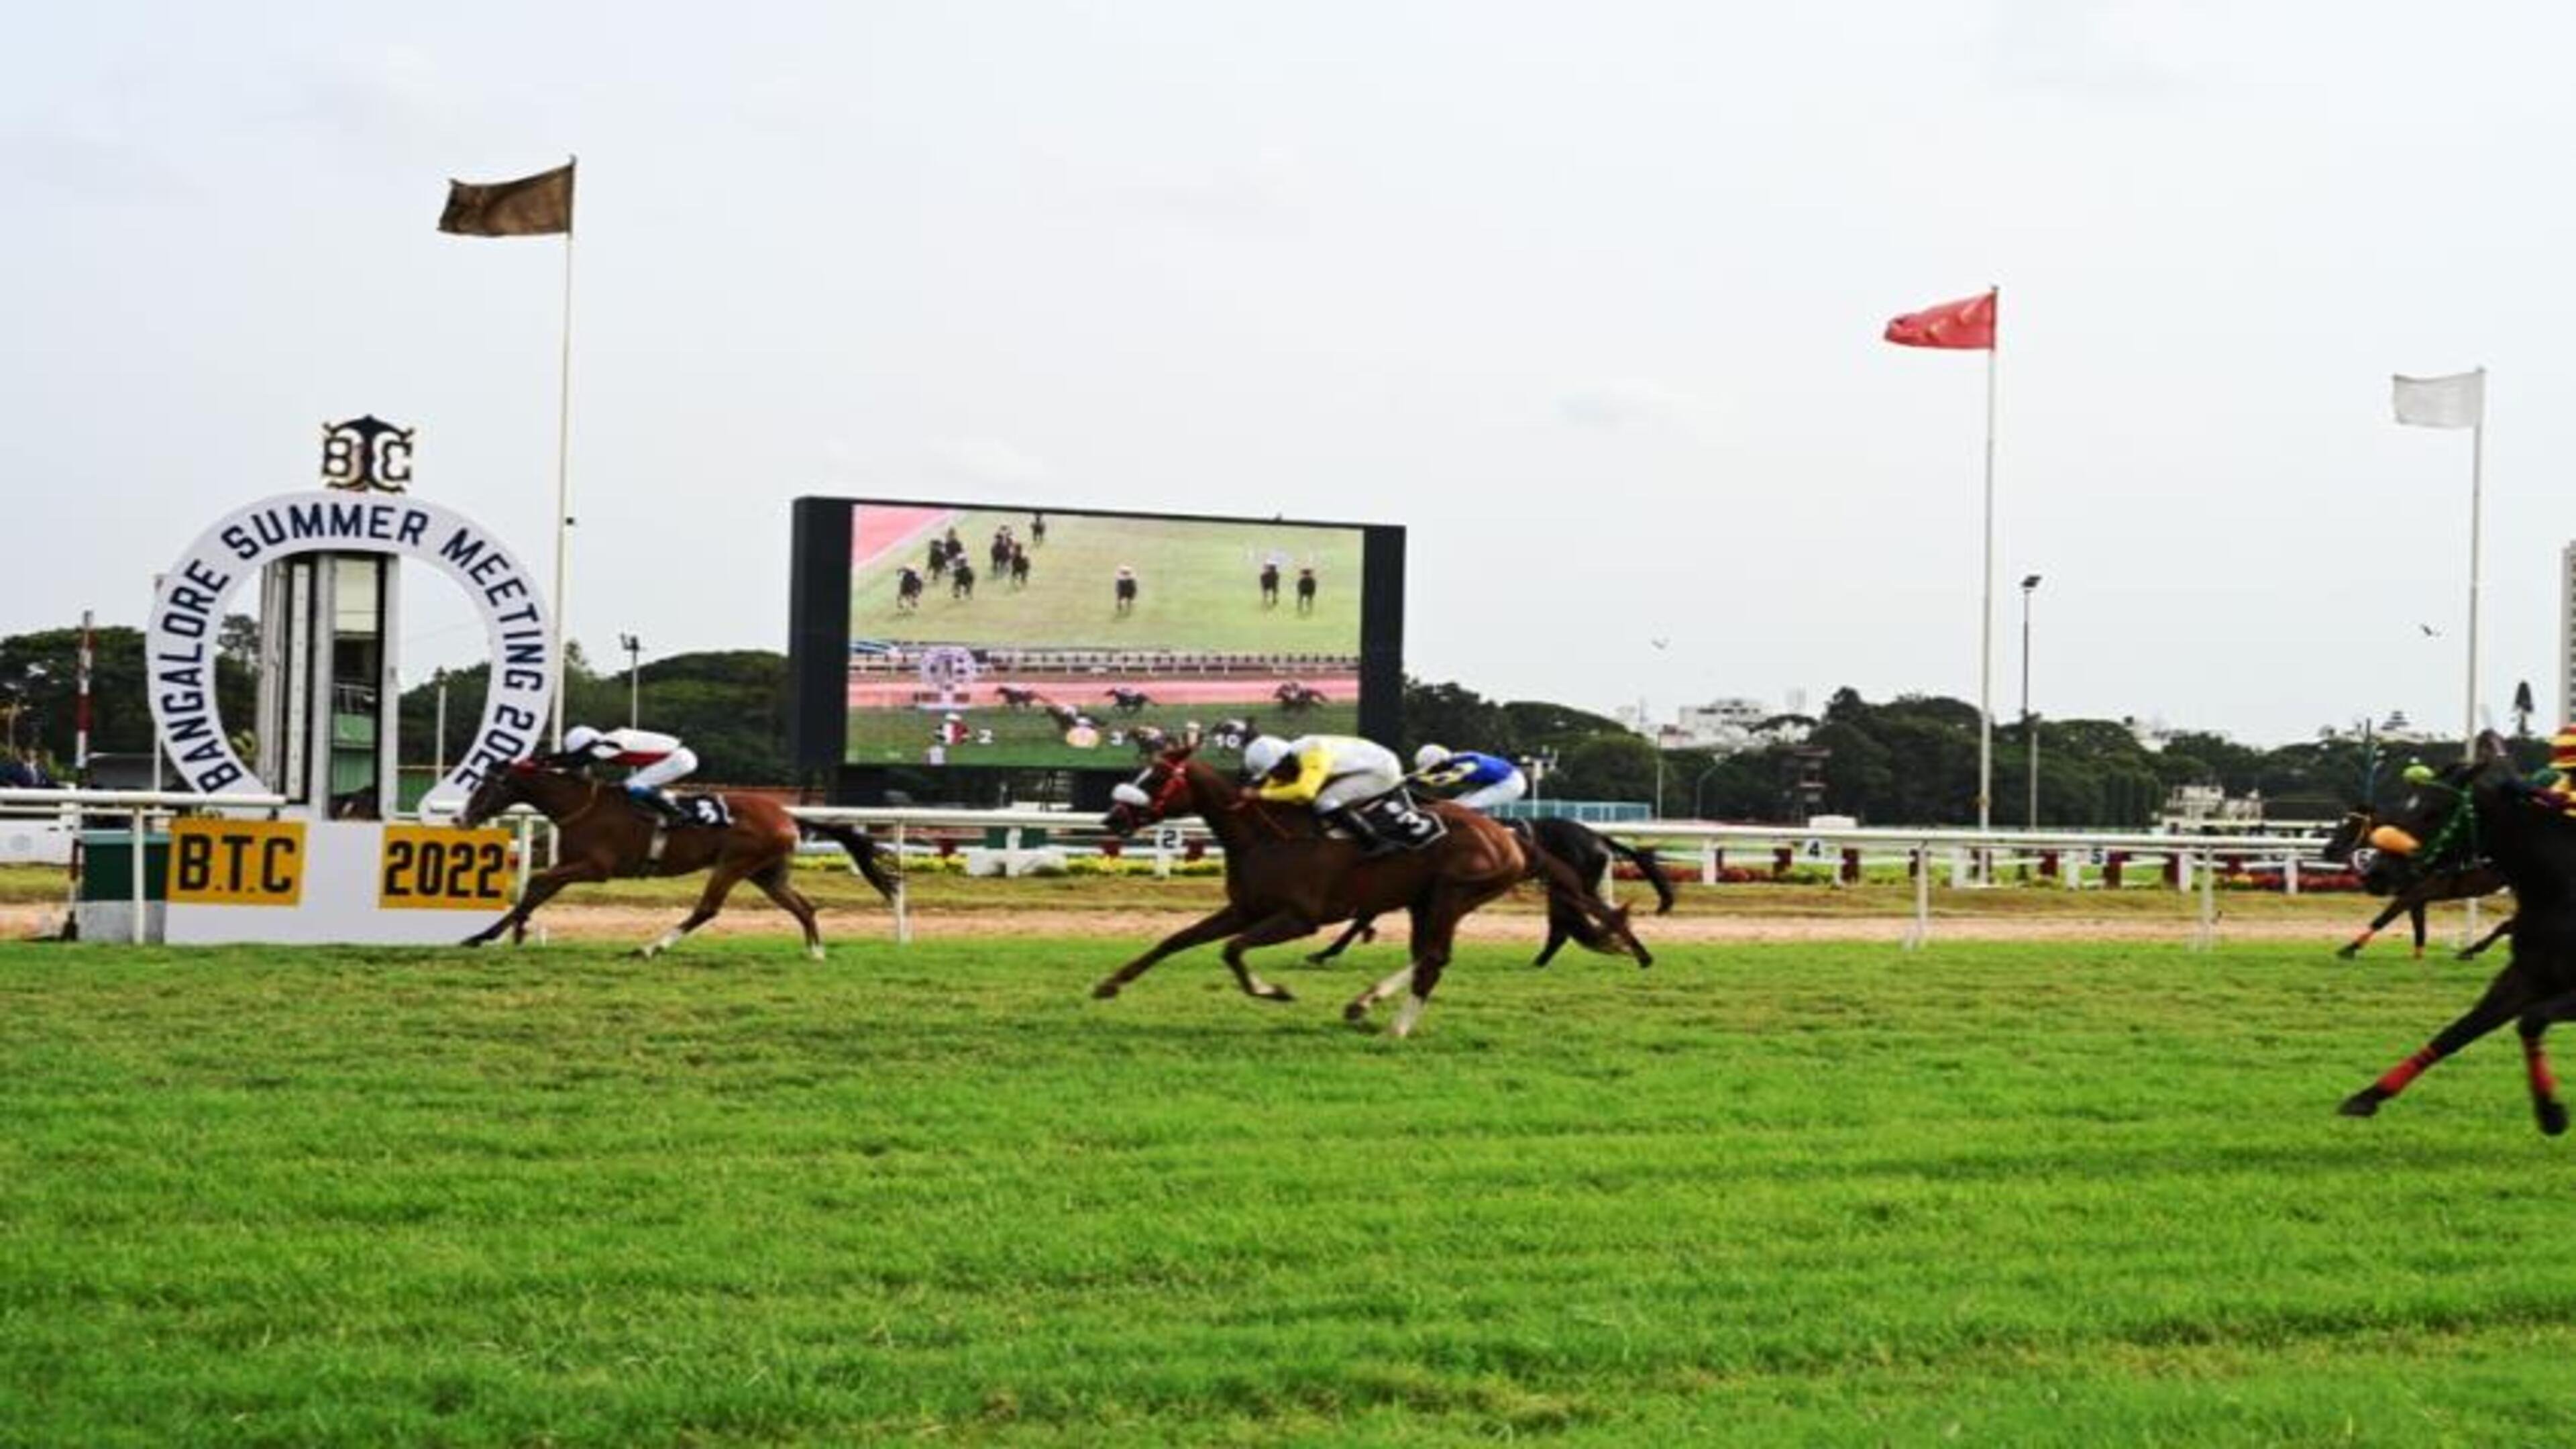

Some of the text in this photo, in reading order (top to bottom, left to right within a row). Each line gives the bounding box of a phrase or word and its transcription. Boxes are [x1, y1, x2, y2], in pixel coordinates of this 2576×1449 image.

[158, 559, 242, 794] BANGALORE
[221, 503, 429, 560] SUMMER
[440, 528, 544, 692] MEETING
[1396, 810, 1432, 836] 3
[1162, 829, 1177, 849] 2
[1809, 840, 1821, 857] 4
[178, 833, 296, 895] B.T.C
[383, 839, 506, 900] 2022
[2091, 848, 2104, 865] 5
